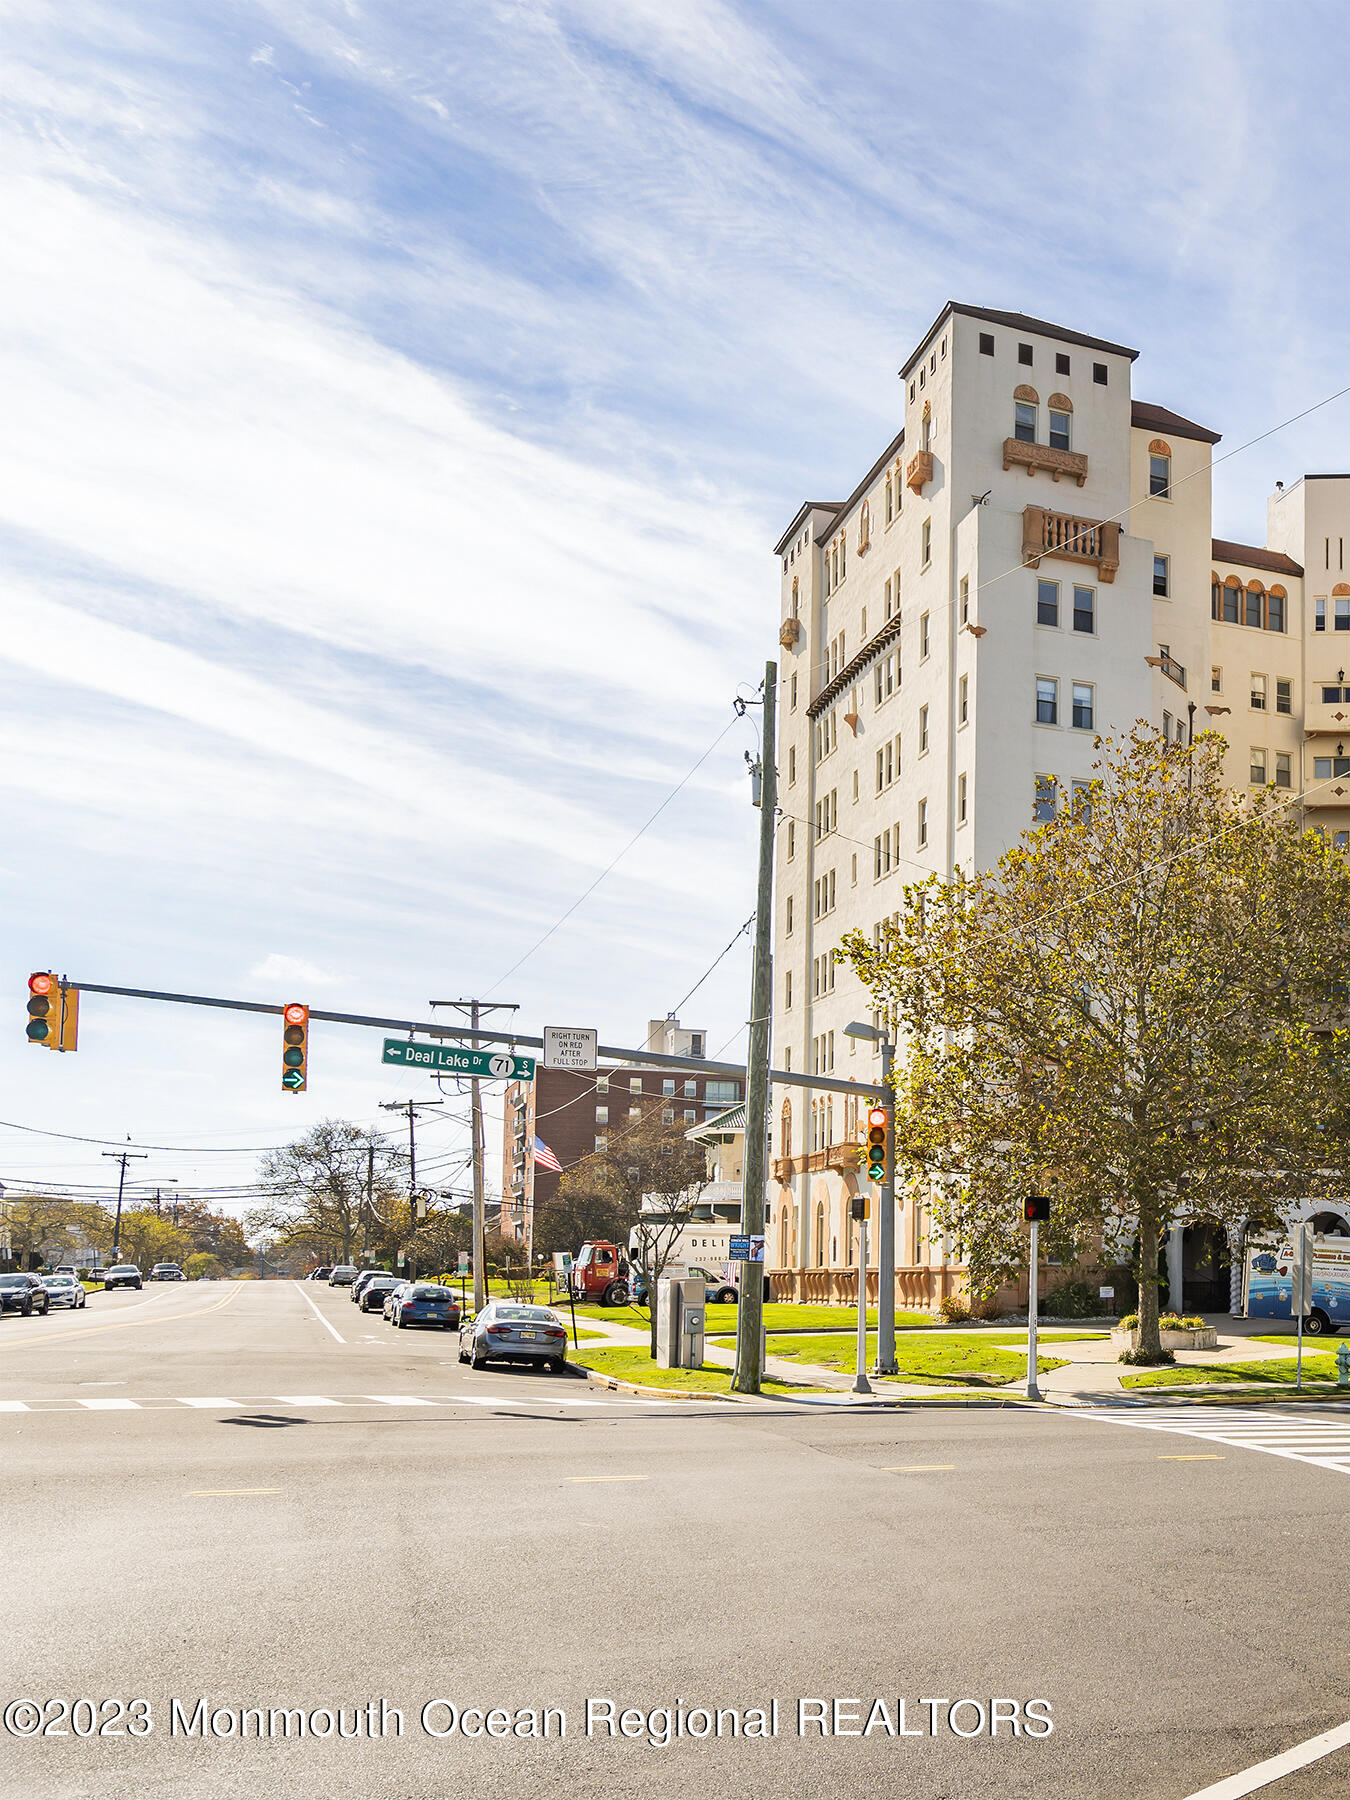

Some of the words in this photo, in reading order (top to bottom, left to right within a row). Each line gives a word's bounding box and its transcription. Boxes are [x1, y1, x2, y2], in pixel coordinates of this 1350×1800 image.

[551, 1031, 571, 1041] RIGHT
[572, 1033, 590, 1041] TURN
[558, 1040, 568, 1049] ON
[570, 1041, 583, 1049] RED
[560, 1049, 581, 1058] AFTER
[405, 1047, 435, 1064] Deal
[438, 1052, 470, 1068] Lake
[472, 1056, 483, 1066] Dr
[494, 1059, 510, 1073] 71
[522, 1060, 529, 1069] S
[553, 1057, 570, 1066] FULL
[571, 1058, 589, 1066] STOP
